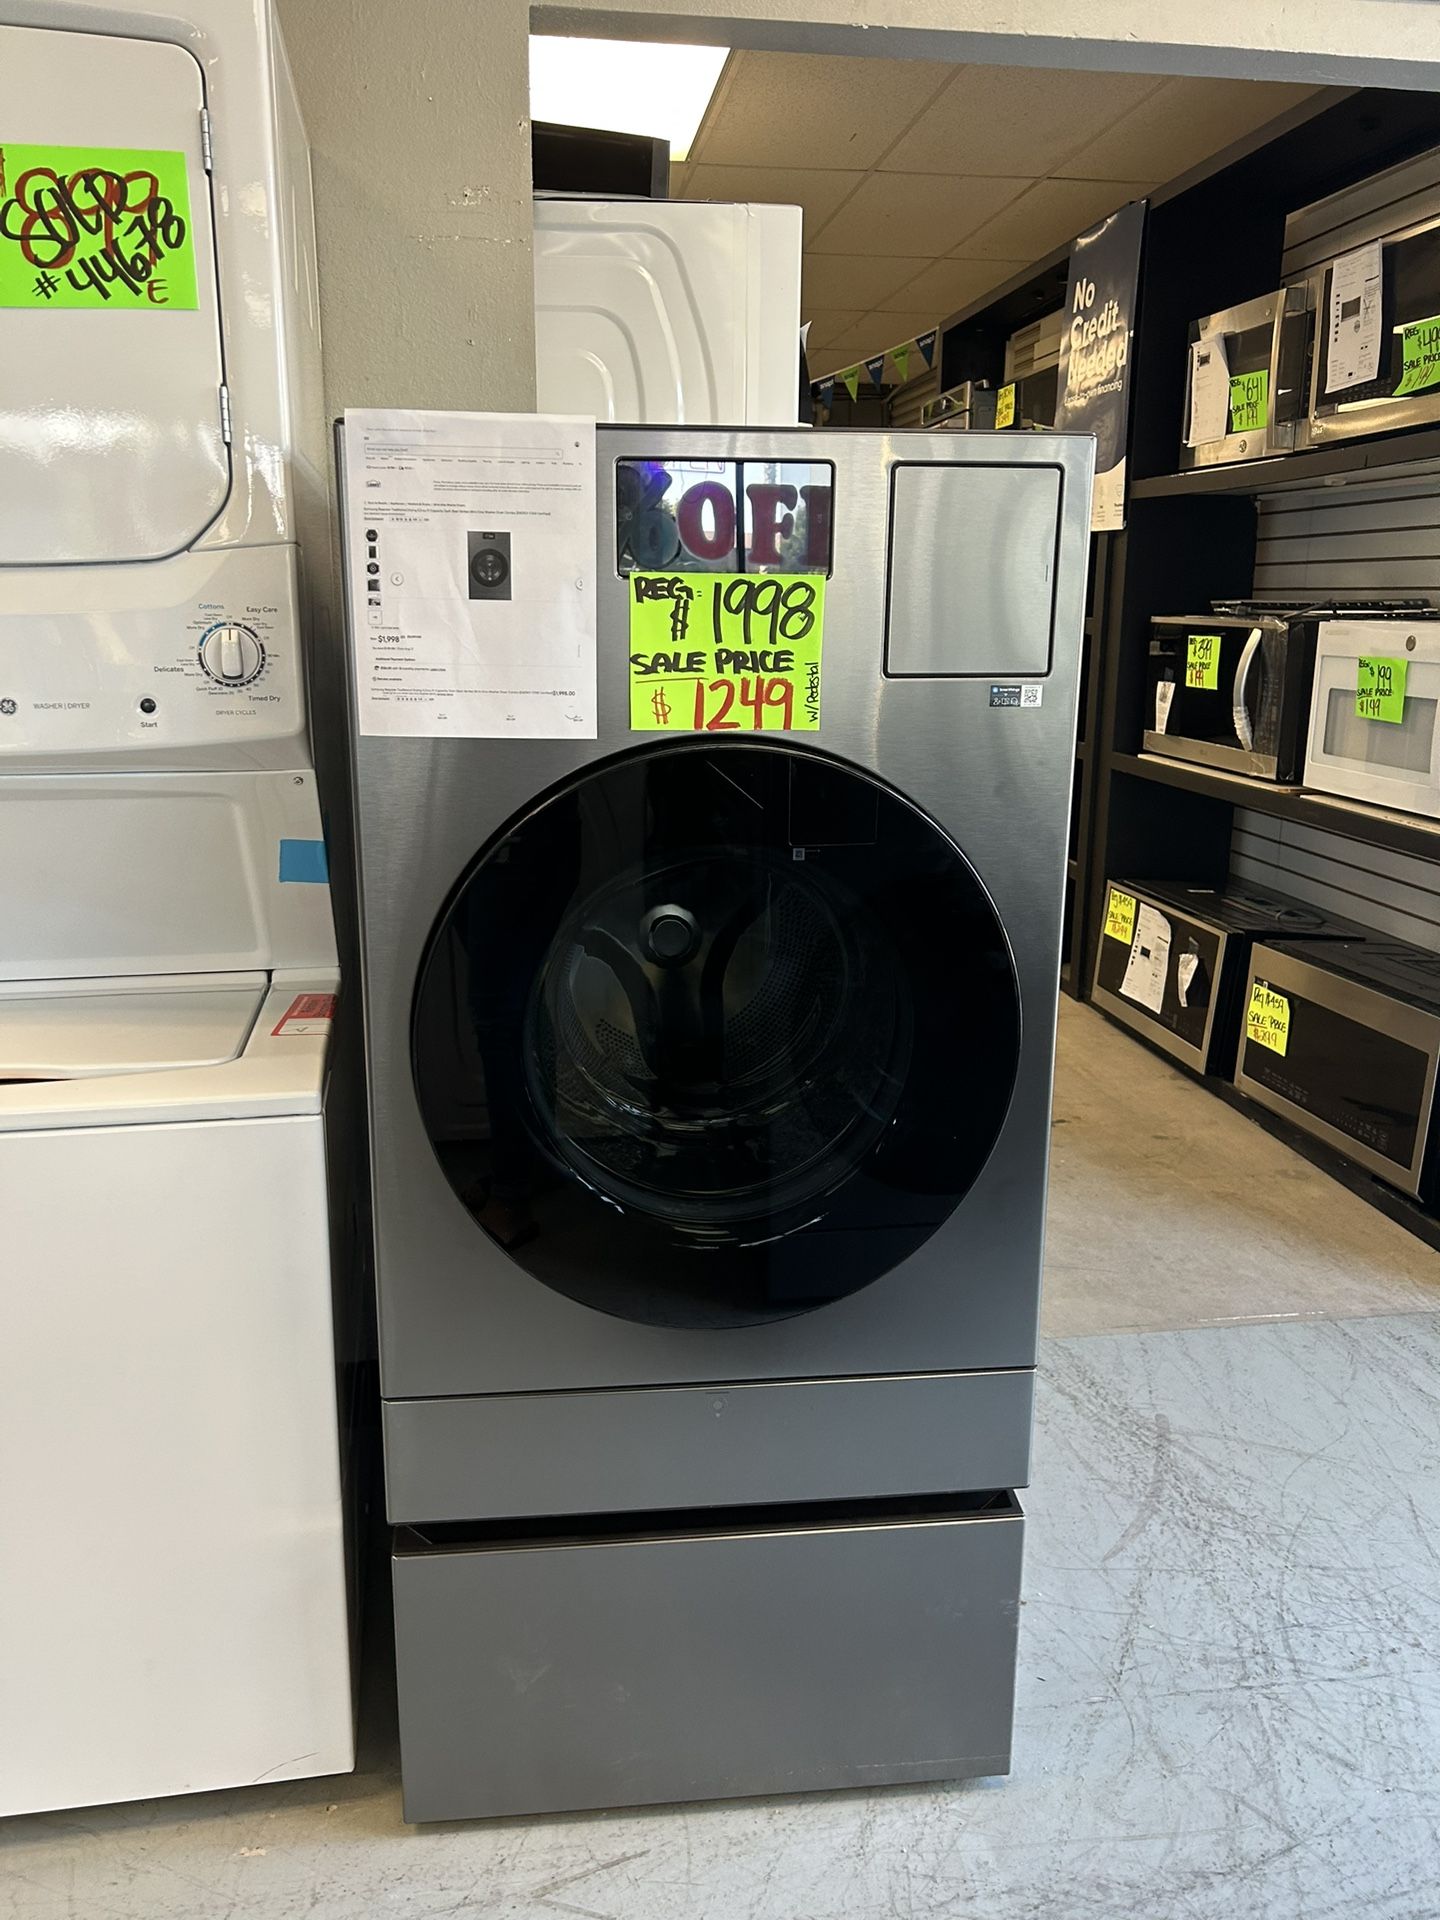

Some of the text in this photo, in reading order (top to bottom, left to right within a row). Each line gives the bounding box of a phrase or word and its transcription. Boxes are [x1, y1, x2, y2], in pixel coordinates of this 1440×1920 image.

[1072, 277, 1096, 314] No
[1070, 299, 1121, 351] Credit
[1417, 326, 1440, 353] $49
[1403, 356, 1421, 371] SALE
[246, 606, 262, 614] Easy
[712, 578, 816, 645] 1998
[630, 648, 795, 676] SALE PRICE
[693, 675, 795, 730] 1249
[1356, 687, 1393, 697] SALE PRICE
[1248, 1010, 1287, 1034] SALE PRICE
